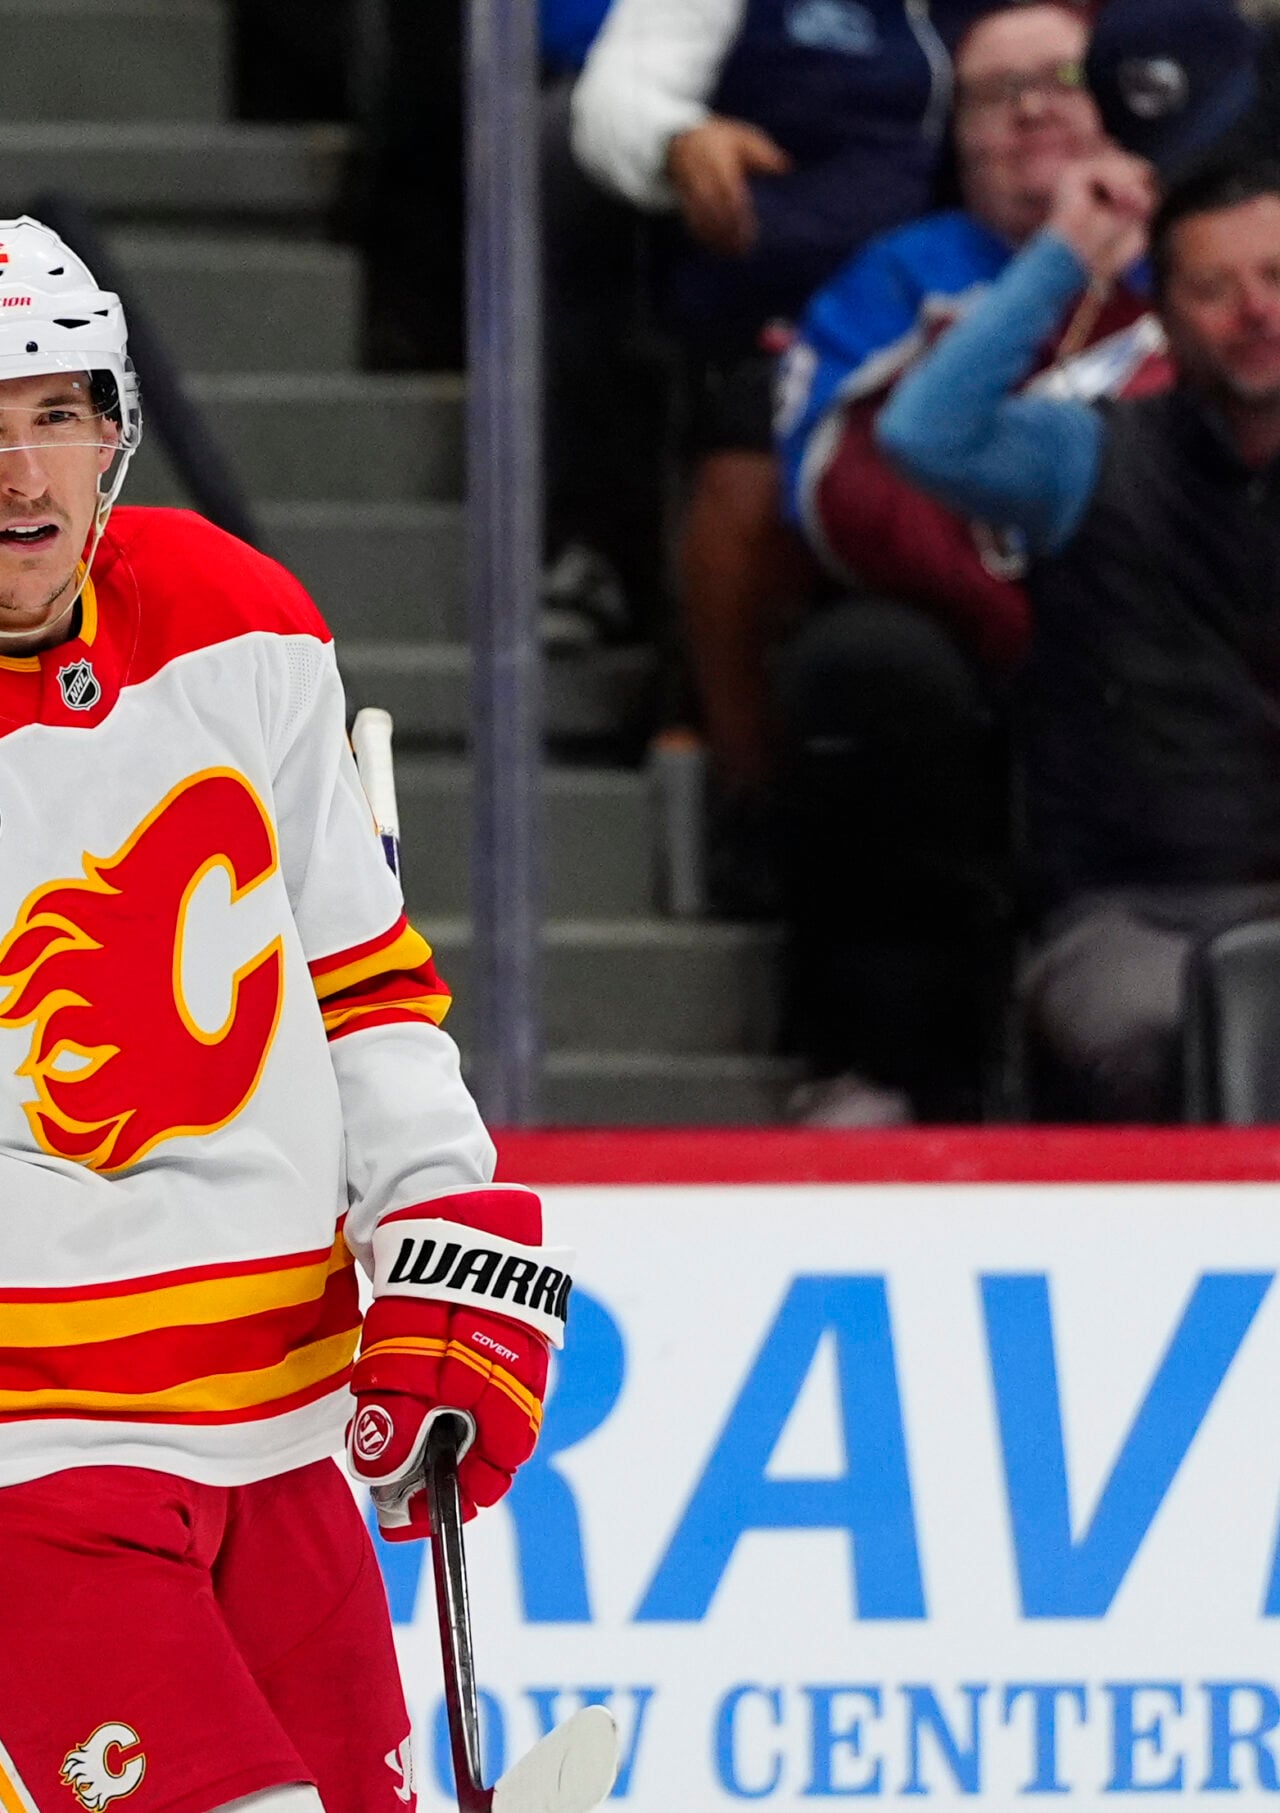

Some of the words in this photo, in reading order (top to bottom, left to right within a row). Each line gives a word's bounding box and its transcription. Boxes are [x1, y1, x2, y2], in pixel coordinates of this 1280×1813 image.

[471, 1330, 519, 1363] COVERT
[370, 1268, 1280, 1624] RAV
[710, 1679, 1280, 1801] CENTER
